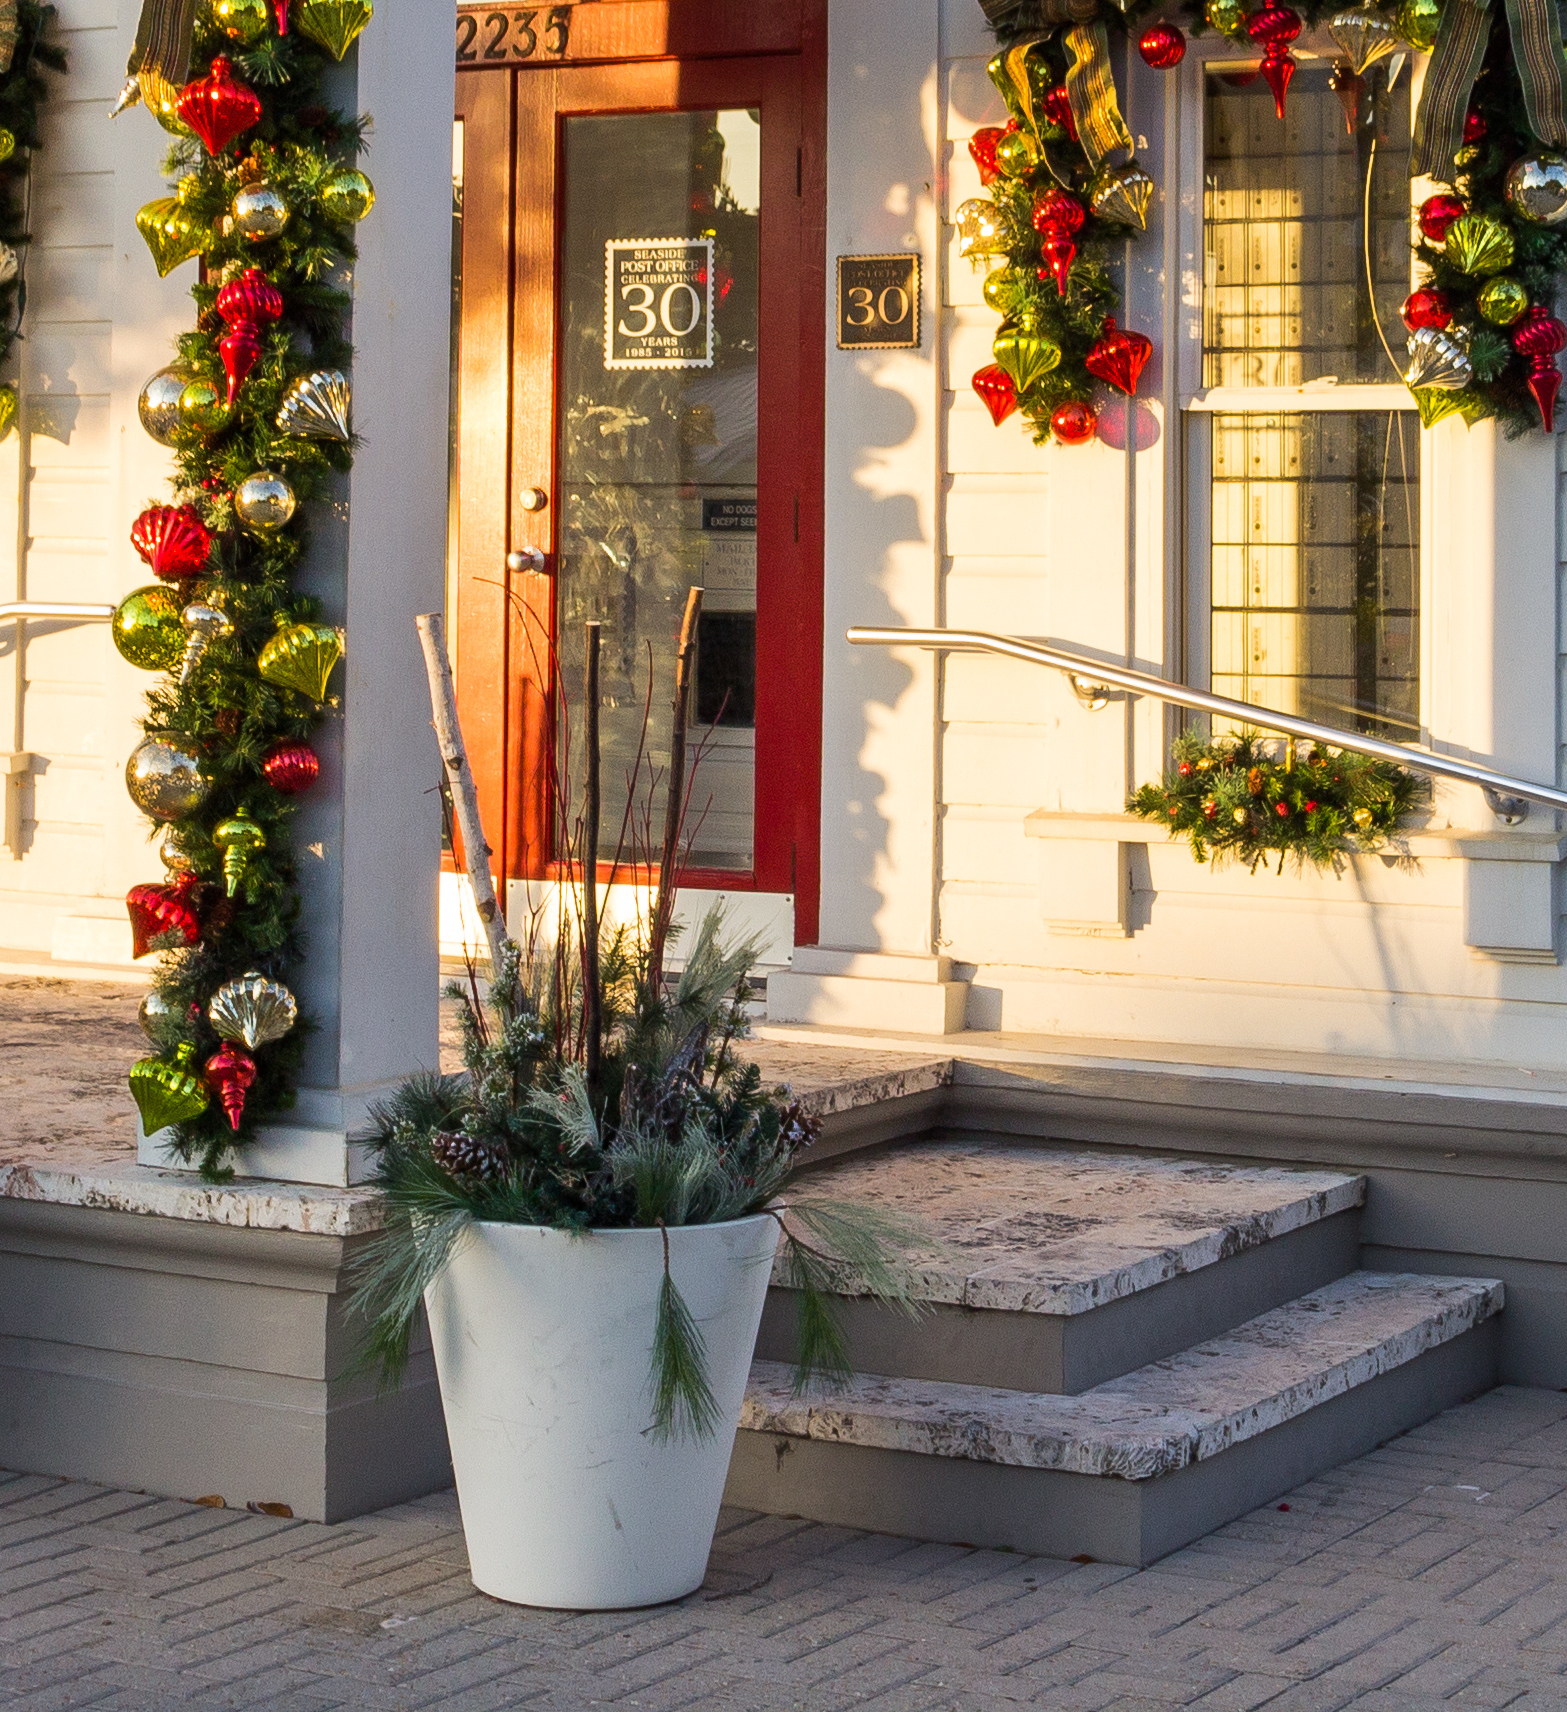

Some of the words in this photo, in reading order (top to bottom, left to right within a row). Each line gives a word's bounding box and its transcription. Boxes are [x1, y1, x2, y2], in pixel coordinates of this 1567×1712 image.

[456, 8, 570, 60] 2235
[634, 249, 685, 260] SEASIDE
[620, 261, 653, 273] POST
[655, 260, 698, 272] OFFICE
[620, 273, 700, 284] CELEBRATING
[618, 283, 701, 337] 30
[846, 286, 909, 326] 30
[640, 336, 678, 347] YEARS
[625, 348, 652, 358] 1985
[722, 505, 734, 514] NO
[735, 505, 757, 514] DOGS
[710, 517, 739, 526] EXCEPT
